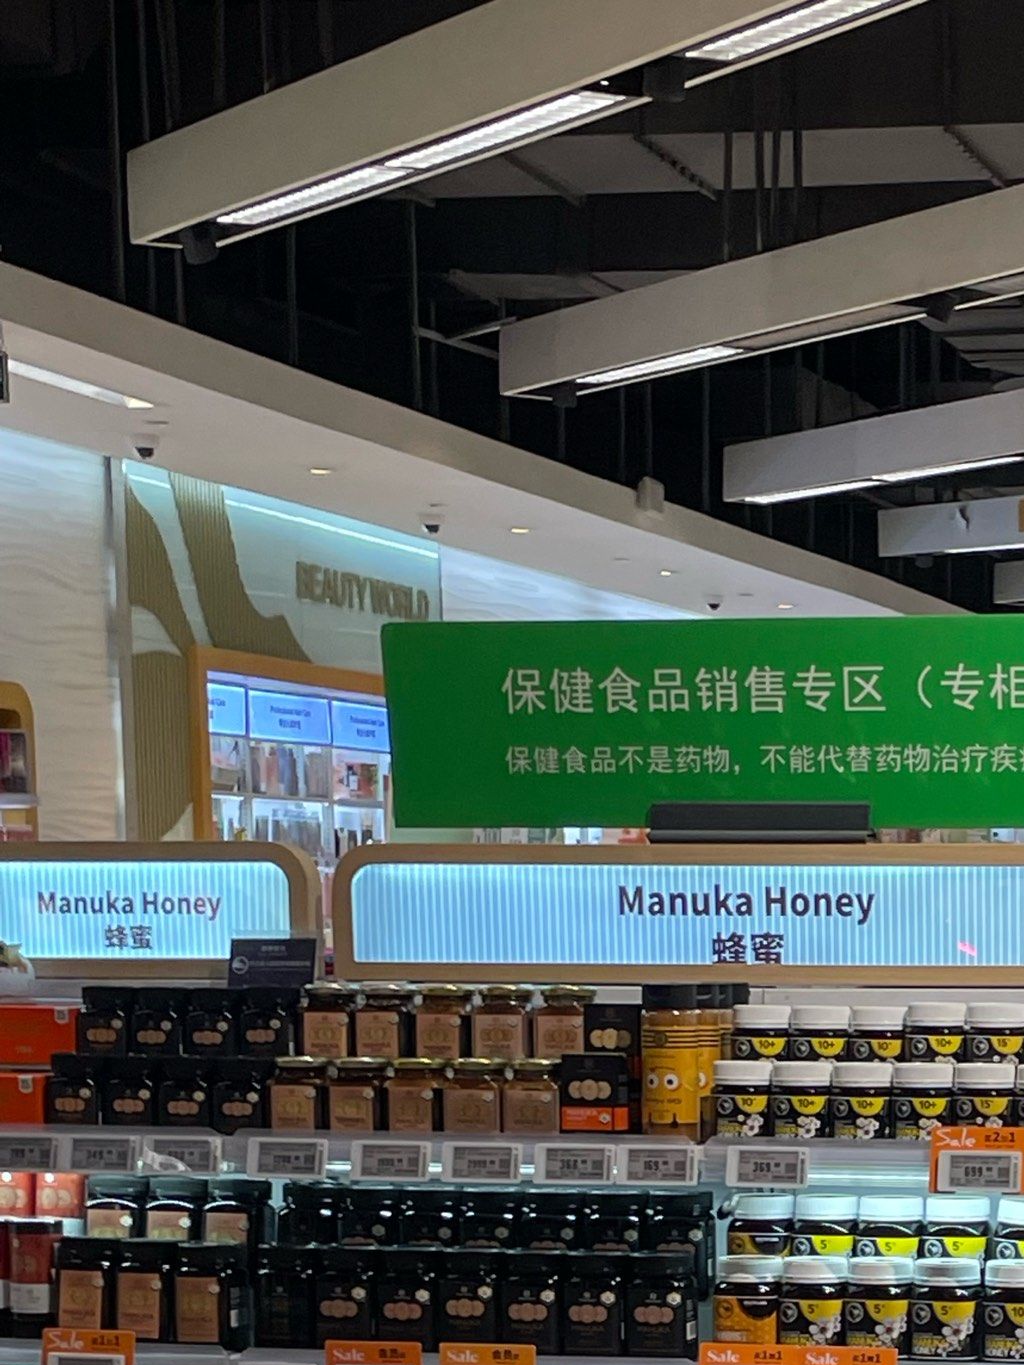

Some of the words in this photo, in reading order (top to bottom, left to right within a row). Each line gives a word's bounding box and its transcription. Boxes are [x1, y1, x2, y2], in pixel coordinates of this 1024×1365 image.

[296, 561, 367, 611] BEAUTY
[369, 578, 429, 621] WORLD
[37, 890, 134, 914] Manuka
[142, 891, 221, 920] Honey
[618, 884, 752, 916] Manuka
[765, 886, 874, 925] Honey
[105, 925, 152, 949] 蜂蜜
[712, 932, 784, 964] 蜂蜜
[936, 1128, 976, 1147] Sale
[50, 1332, 85, 1349] Sale
[333, 1349, 365, 1361] Sale
[447, 1350, 478, 1363] Sale
[707, 1350, 740, 1363] Sale
[805, 1353, 840, 1365] Sale
